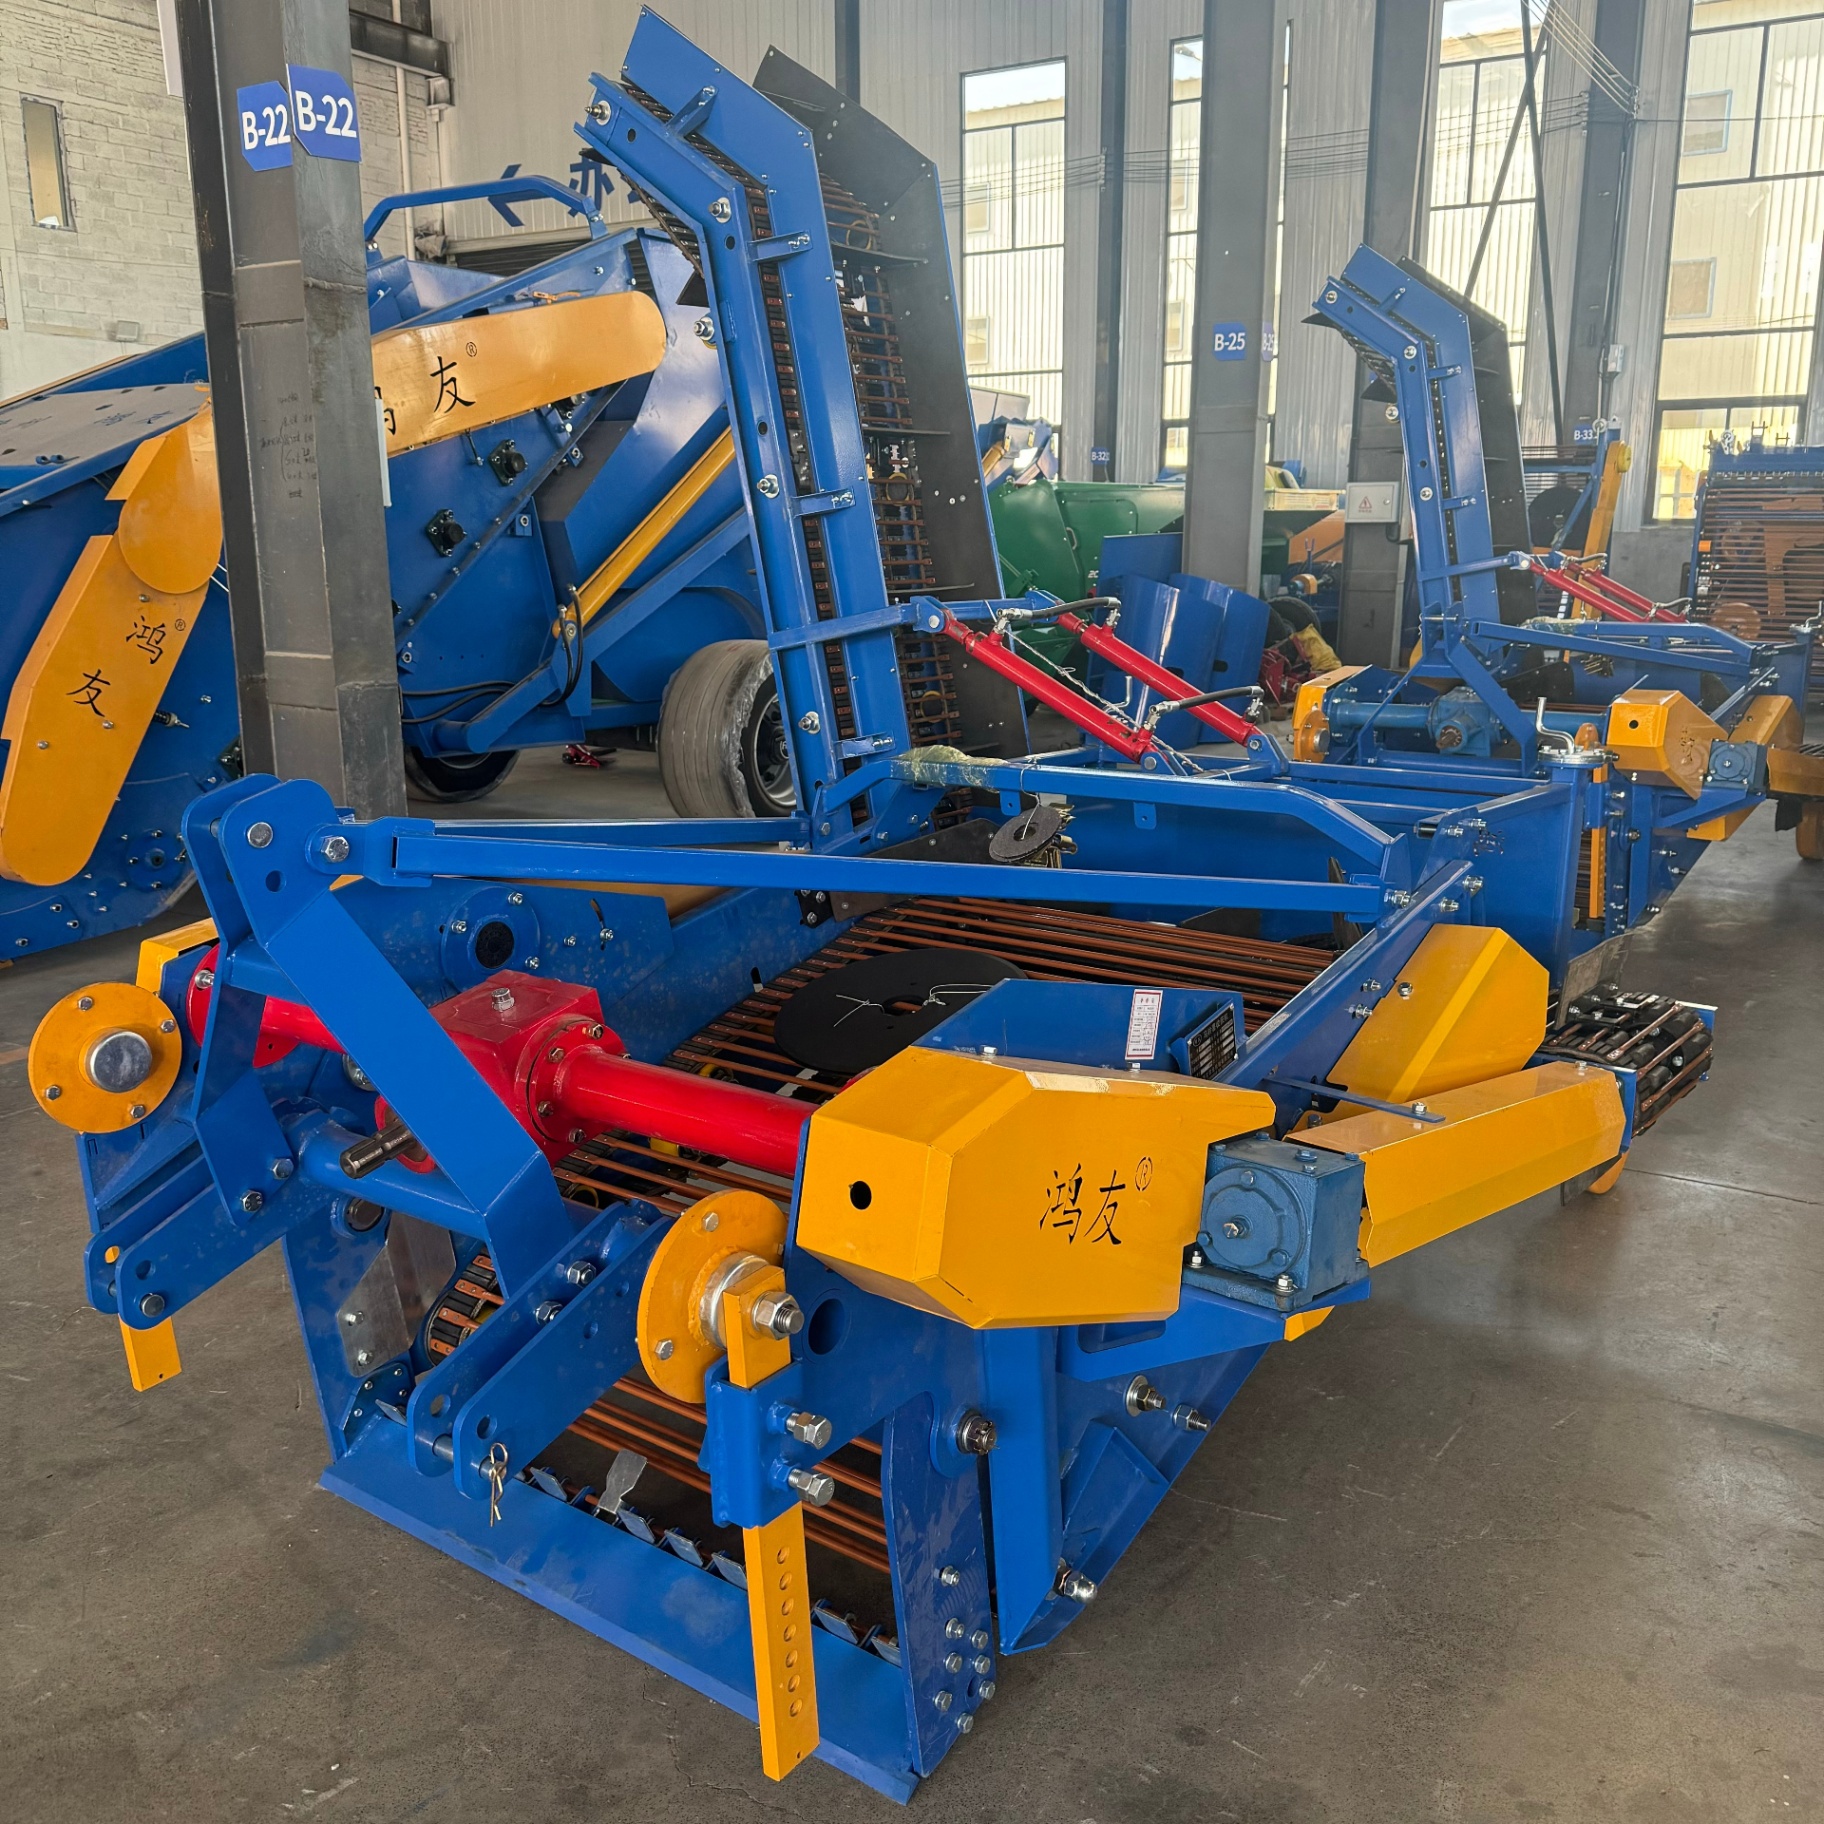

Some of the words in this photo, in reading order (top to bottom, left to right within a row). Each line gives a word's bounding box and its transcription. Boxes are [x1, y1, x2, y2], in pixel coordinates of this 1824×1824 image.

[242, 104, 291, 150] B-22
[295, 90, 357, 138] B-22
[1214, 332, 1246, 351] B-25
[1574, 430, 1593, 440] B-33
[66, 615, 166, 717] 鸿友
[1039, 1162, 1126, 1245] 鸿友
